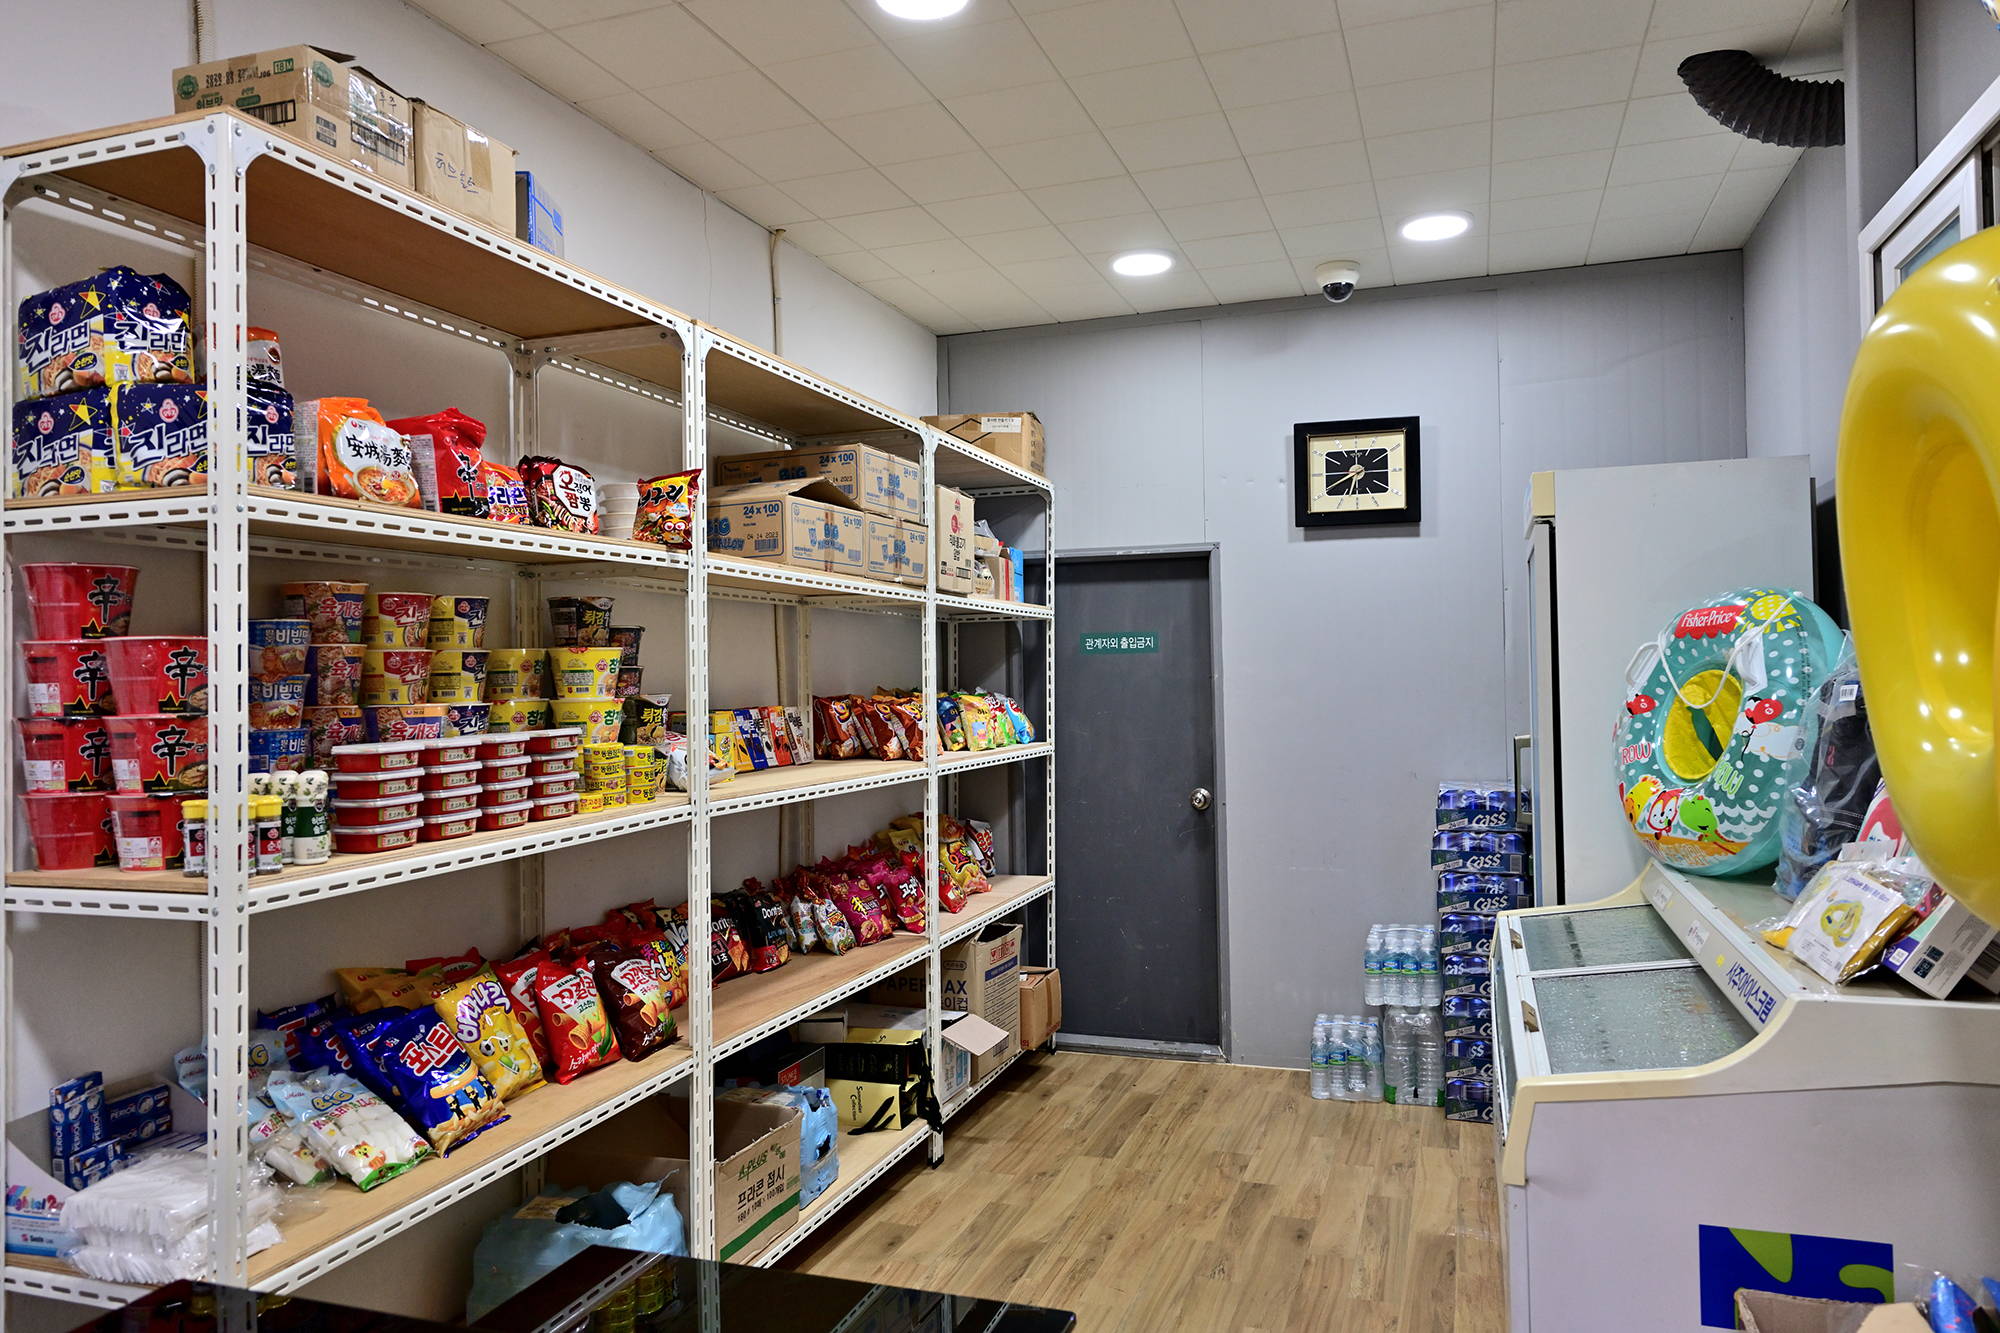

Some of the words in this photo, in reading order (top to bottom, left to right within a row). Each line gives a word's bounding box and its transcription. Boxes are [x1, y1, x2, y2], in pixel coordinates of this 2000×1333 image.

[26, 319, 90, 376] 진라면
[115, 320, 187, 353] 진라면
[819, 455, 830, 465] 24
[838, 453, 854, 462] 100
[559, 469, 592, 496] 오징어
[564, 490, 592, 512] 짬뽕
[743, 505, 755, 516] 24
[763, 503, 780, 513] 100
[87, 573, 124, 625] 辛
[319, 597, 364, 618] 육개장
[1681, 610, 1735, 628] Fisher-Price
[276, 628, 310, 644] 비빔면
[1085, 637, 1118, 650] 관계자외
[1120, 636, 1154, 649] 출입금지
[164, 646, 204, 699] 辛
[389, 720, 440, 741] 육개장
[151, 724, 196, 778] 辛
[1622, 742, 1651, 766] ROW
[1714, 758, 1744, 796] ROW
[400, 1022, 466, 1076] 포스틱
[311, 1089, 355, 1112] BiG
[110, 1105, 136, 1121] PERIOE
[55, 1125, 63, 1156] PERIOE
[737, 1178, 764, 1210] 프라콘
[767, 1164, 785, 1189] 접시
